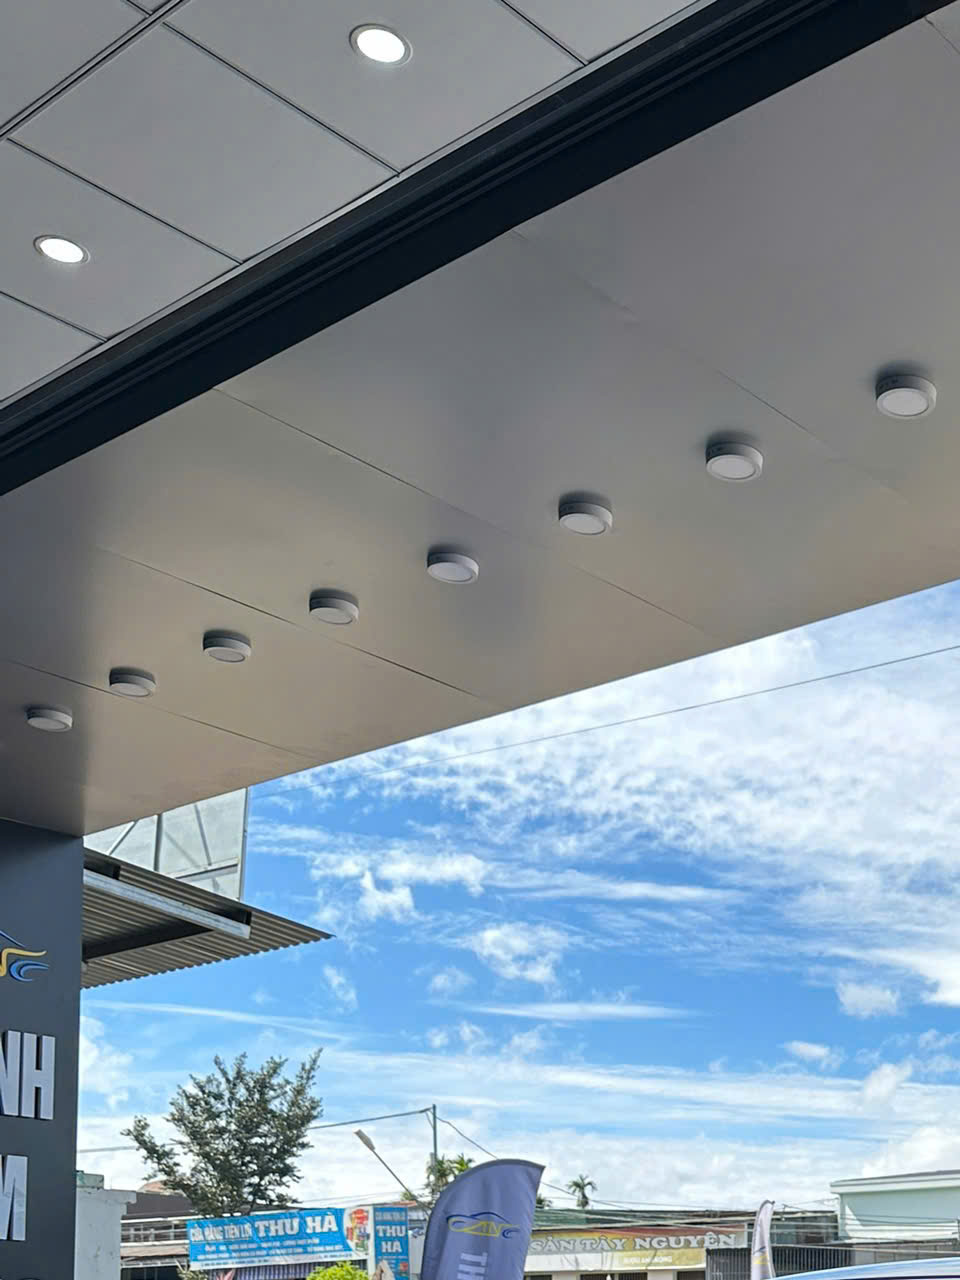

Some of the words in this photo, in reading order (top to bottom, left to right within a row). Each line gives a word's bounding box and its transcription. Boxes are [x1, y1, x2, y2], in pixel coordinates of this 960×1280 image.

[255, 1217, 300, 1238] THU
[306, 1211, 338, 1234] HÀ
[376, 1225, 407, 1238] THU
[579, 1234, 627, 1251] TÂY
[633, 1231, 738, 1250] NGUYÊN
